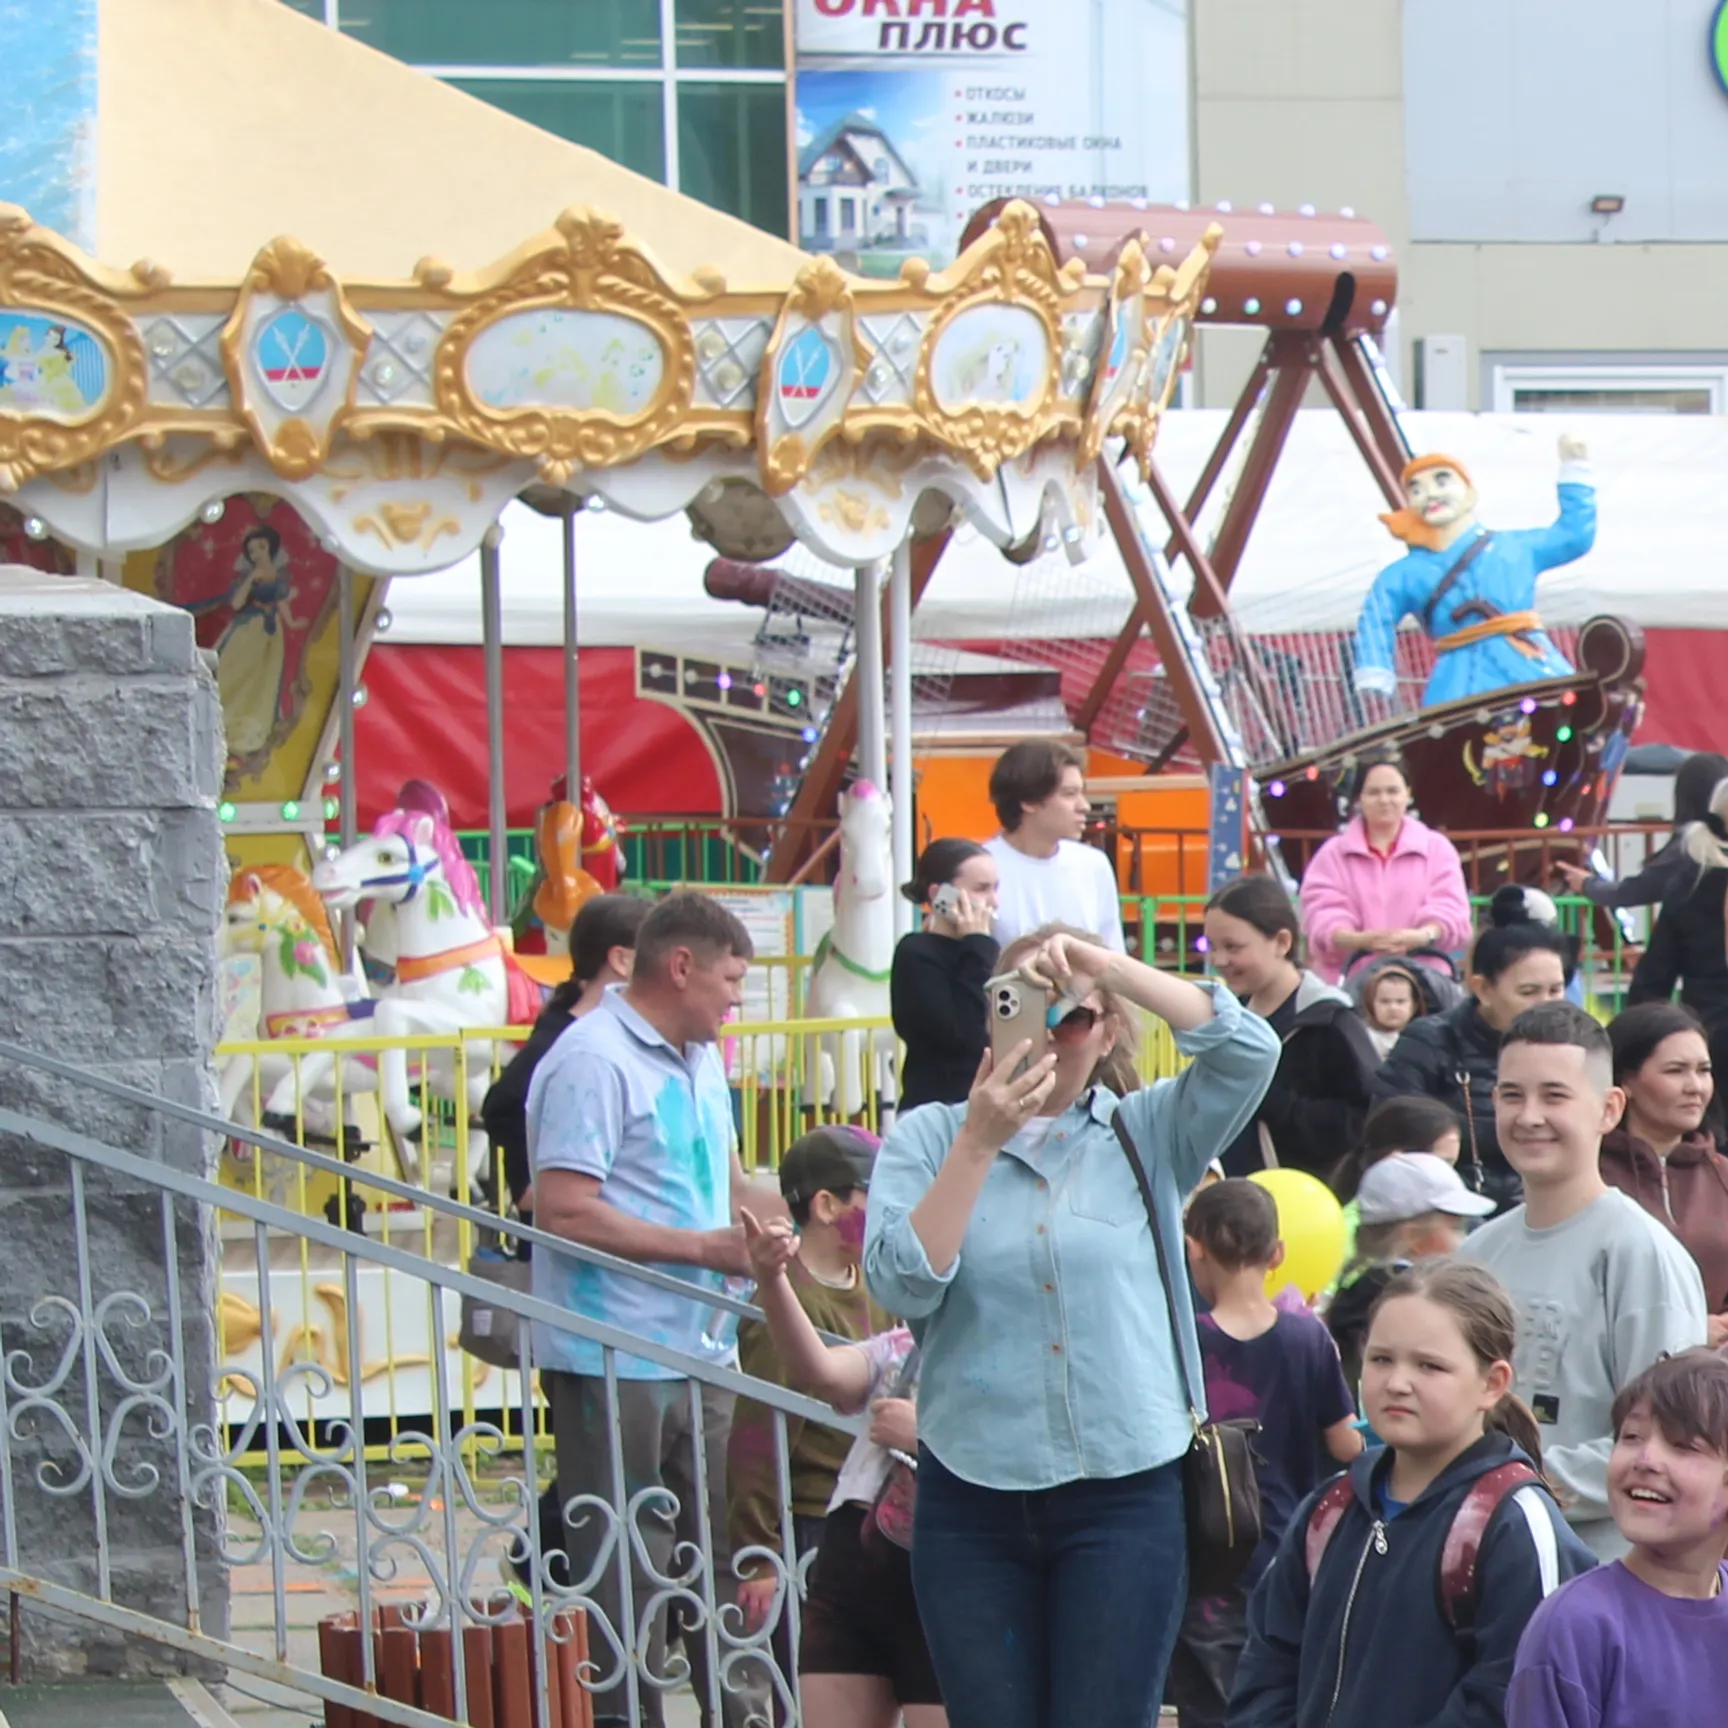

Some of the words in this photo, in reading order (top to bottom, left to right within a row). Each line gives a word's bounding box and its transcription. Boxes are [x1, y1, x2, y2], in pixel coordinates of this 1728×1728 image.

[879, 22, 1028, 50] ПЛЮС
[965, 87, 1026, 101] ОТКОСЫ
[966, 111, 1034, 125] ЖАЛЮЗИ
[966, 136, 1077, 150] ПЛАСТИКОВЫЕ
[1082, 136, 1122, 150] ОКНА
[967, 161, 977, 173] И
[983, 160, 1032, 174] ДВЕРИ
[968, 184, 1063, 198] ОСТЕКЛЕНИЕ
